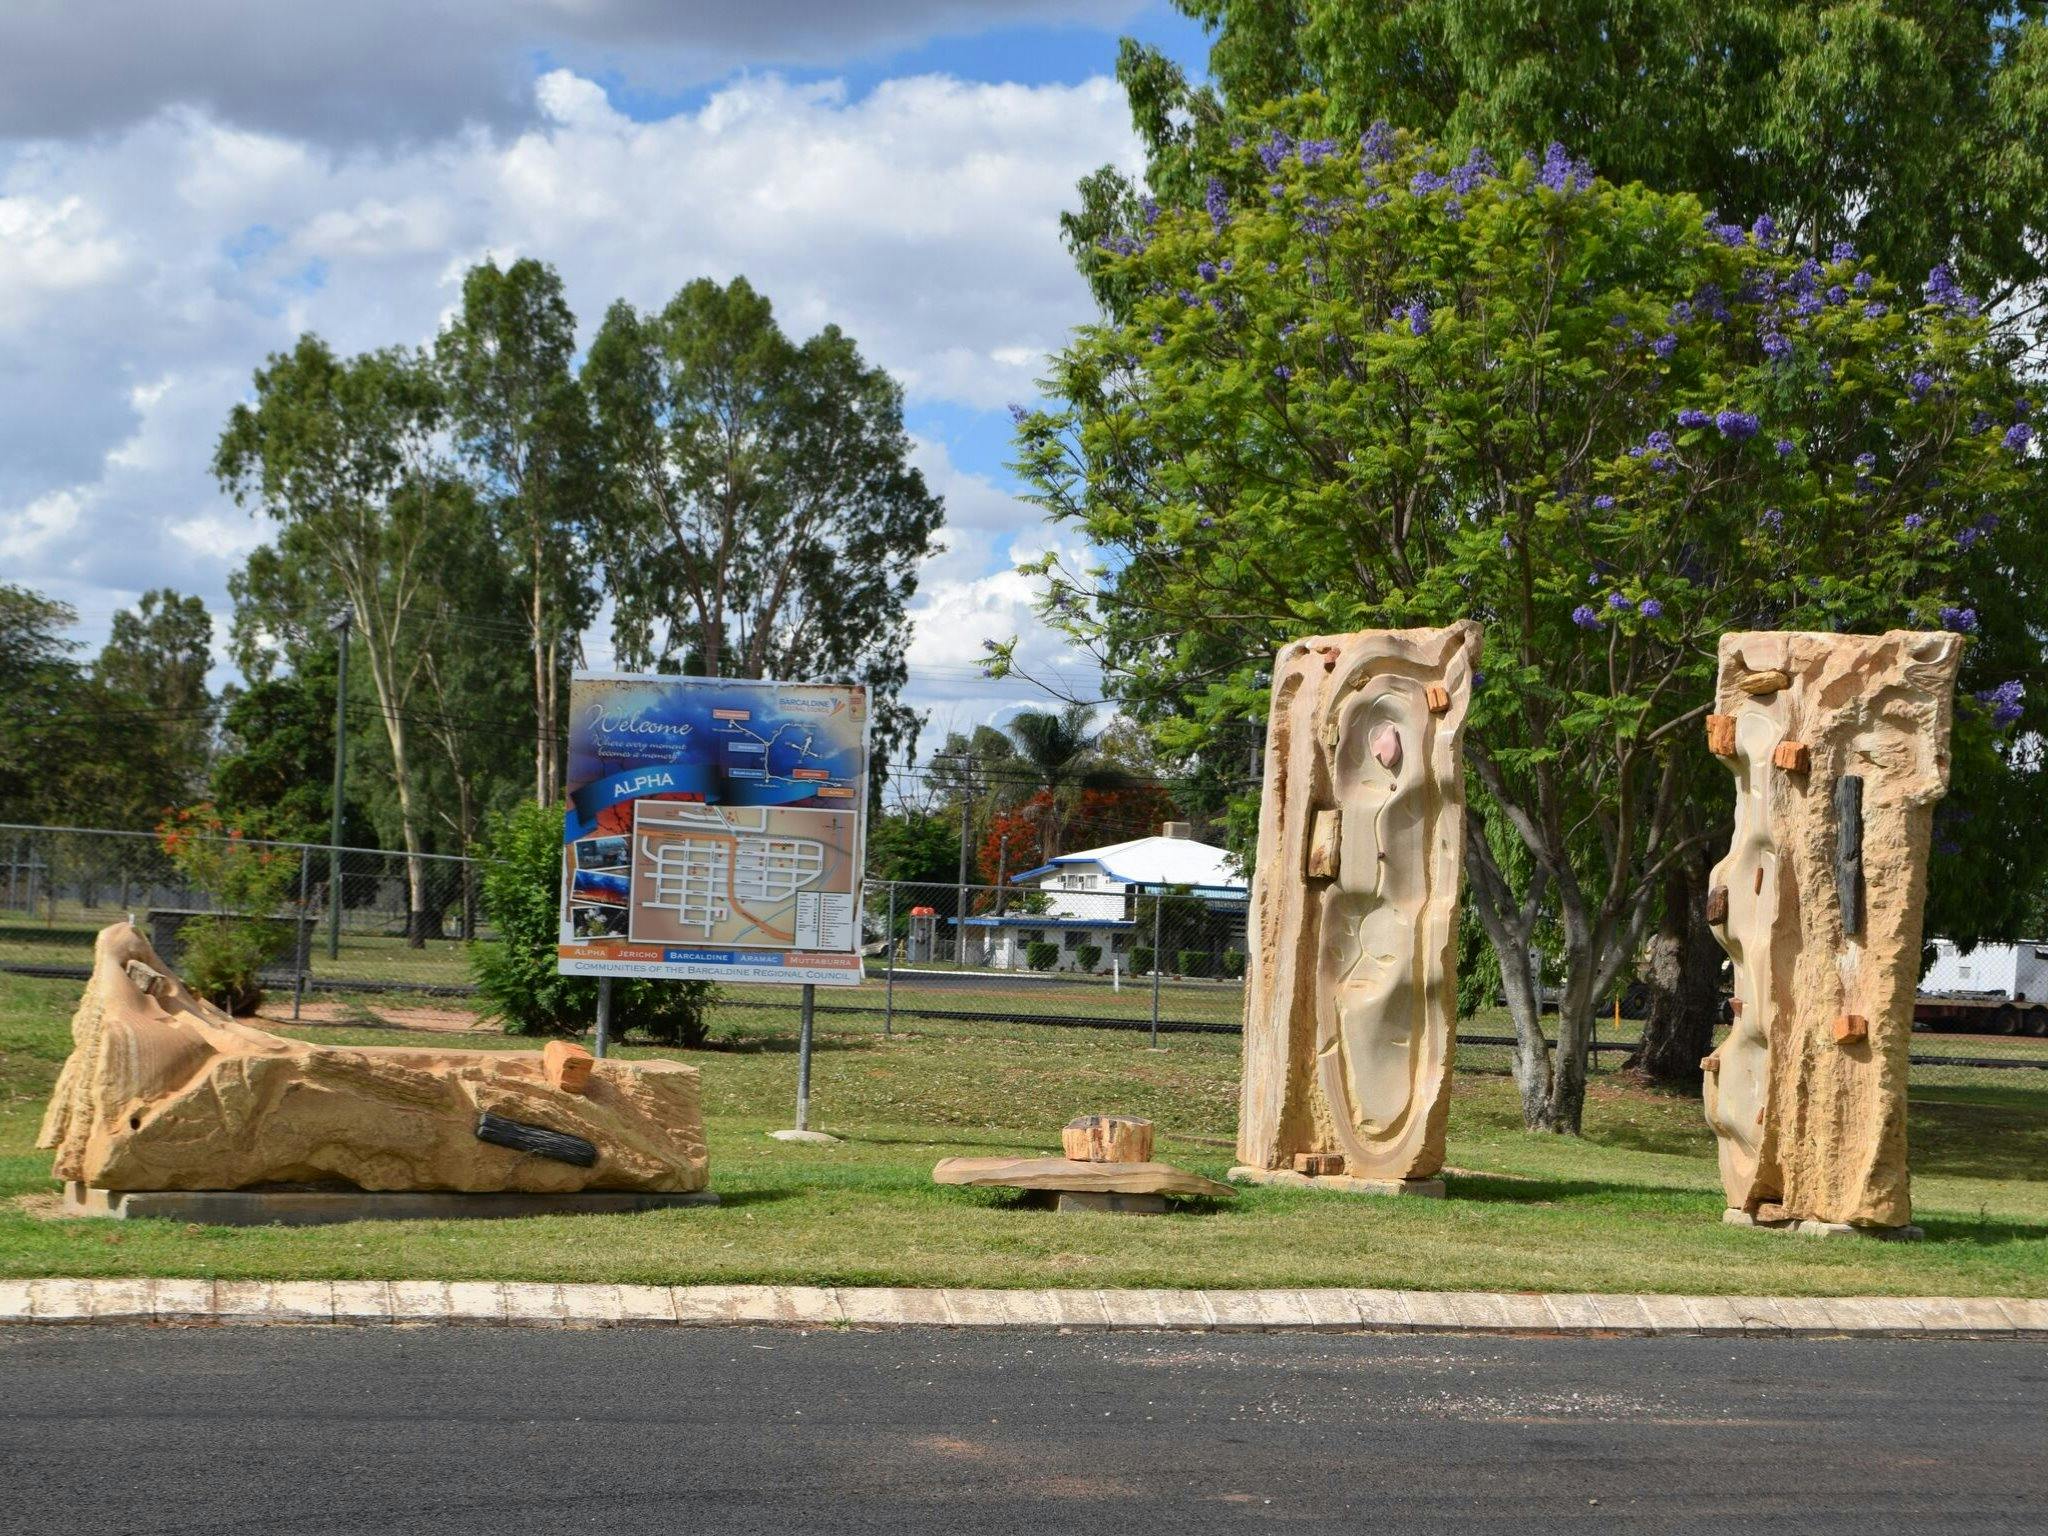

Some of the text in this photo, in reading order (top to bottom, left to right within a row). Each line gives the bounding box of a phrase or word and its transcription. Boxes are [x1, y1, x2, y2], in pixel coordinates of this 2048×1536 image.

[585, 703, 693, 735] Welcome
[614, 772, 674, 798] ALPHA
[574, 949, 606, 957] ALPHA
[618, 950, 658, 958] JERICHO
[670, 951, 728, 961] BARCALDINE
[790, 956, 852, 966] MUTTABURRA
[574, 961, 850, 980] COMMUNITIES OF THE BARCALDINE REGIONAL COUNCIL
